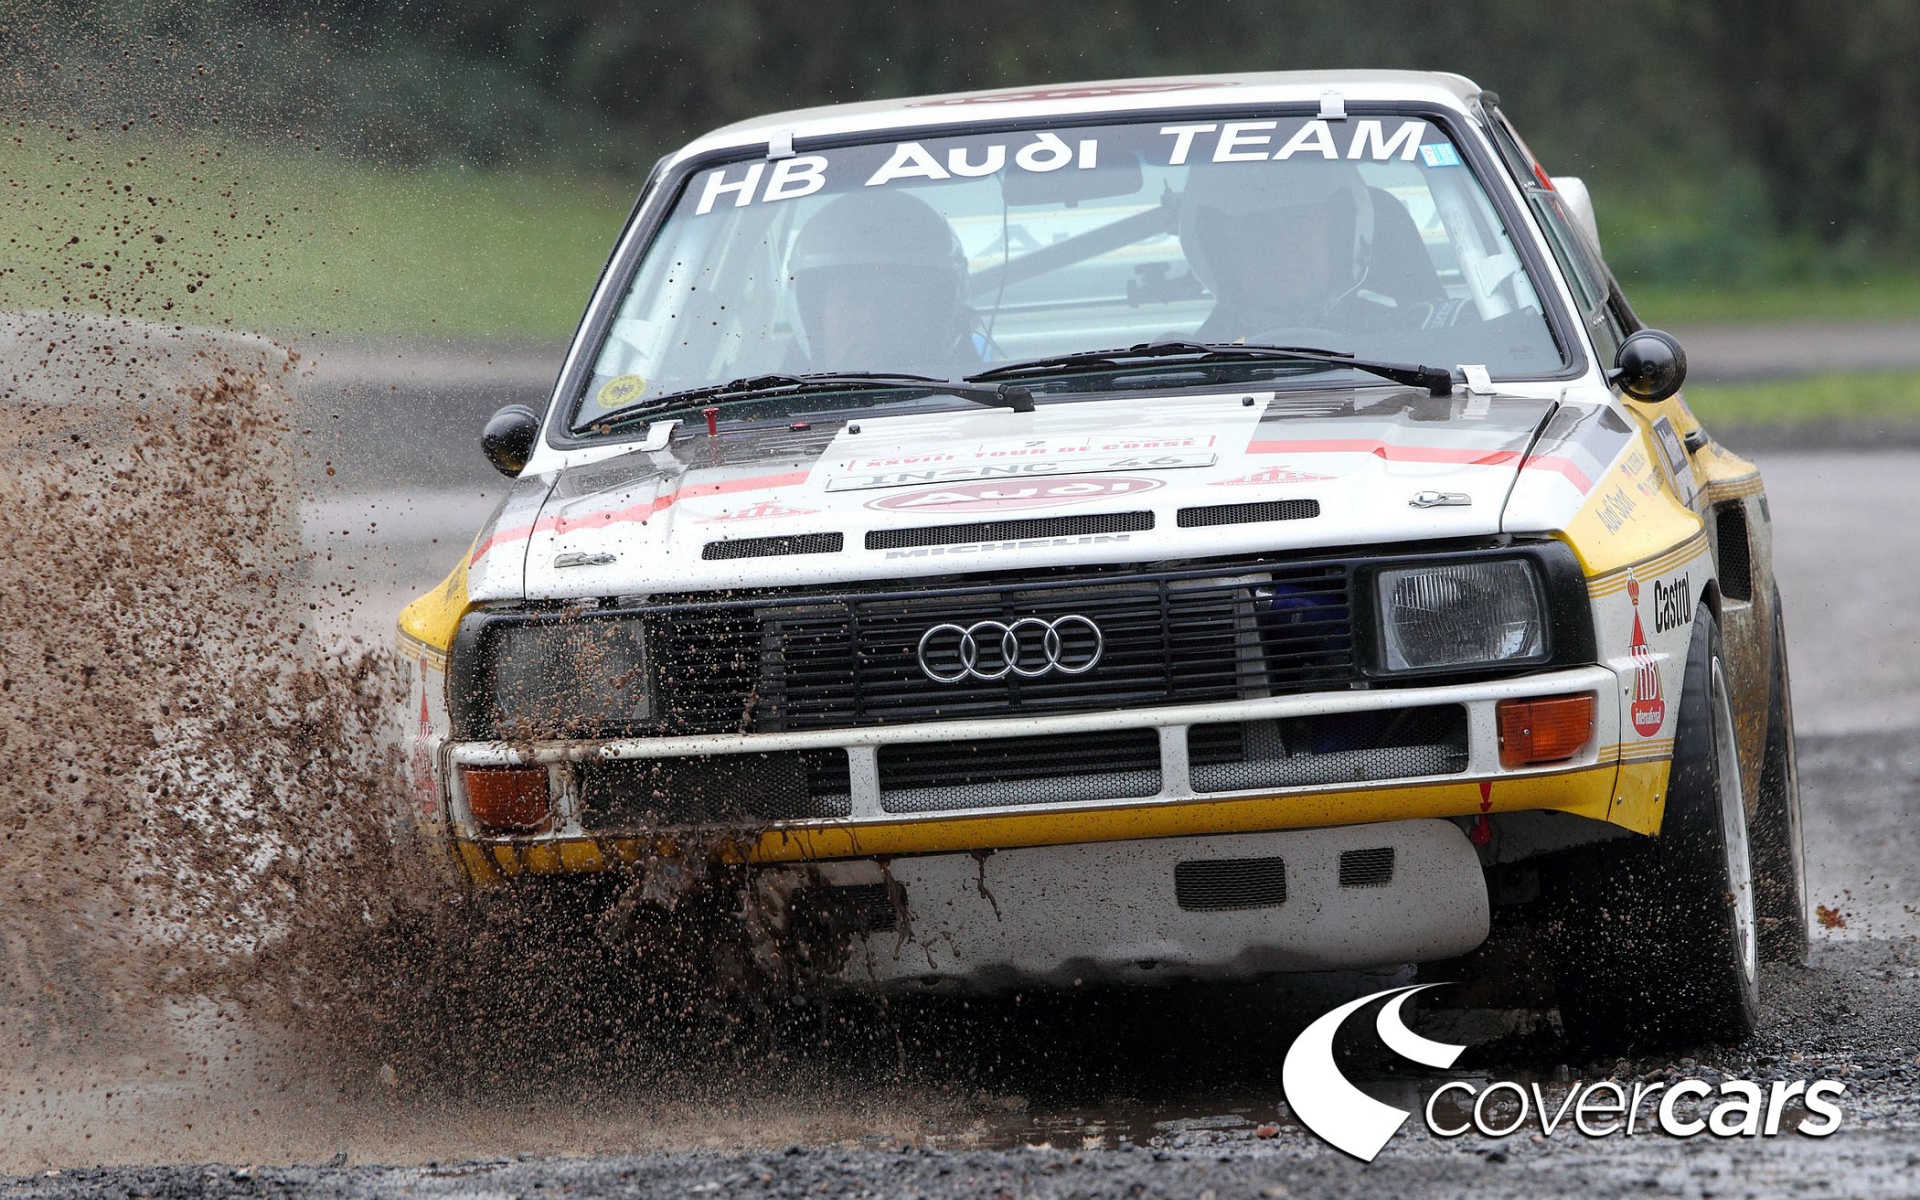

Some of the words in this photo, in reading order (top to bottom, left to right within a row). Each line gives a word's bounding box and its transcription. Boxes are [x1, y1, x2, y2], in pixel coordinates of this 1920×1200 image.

[695, 155, 829, 216] HB
[864, 132, 1099, 187] Audi
[1159, 120, 1428, 165] TEAM
[973, 448, 1048, 459] TOUR
[1058, 444, 1092, 453] DE
[1102, 439, 1196, 450] CORSE
[1109, 455, 1184, 467] 46
[895, 480, 1131, 508] Audi
[1605, 483, 1637, 522] Sport
[1595, 498, 1624, 536] Audi
[885, 534, 1131, 560] MICHELIN
[1654, 571, 1692, 634] Castrol
[1628, 644, 1659, 701] HB
[1635, 705, 1662, 725] international
